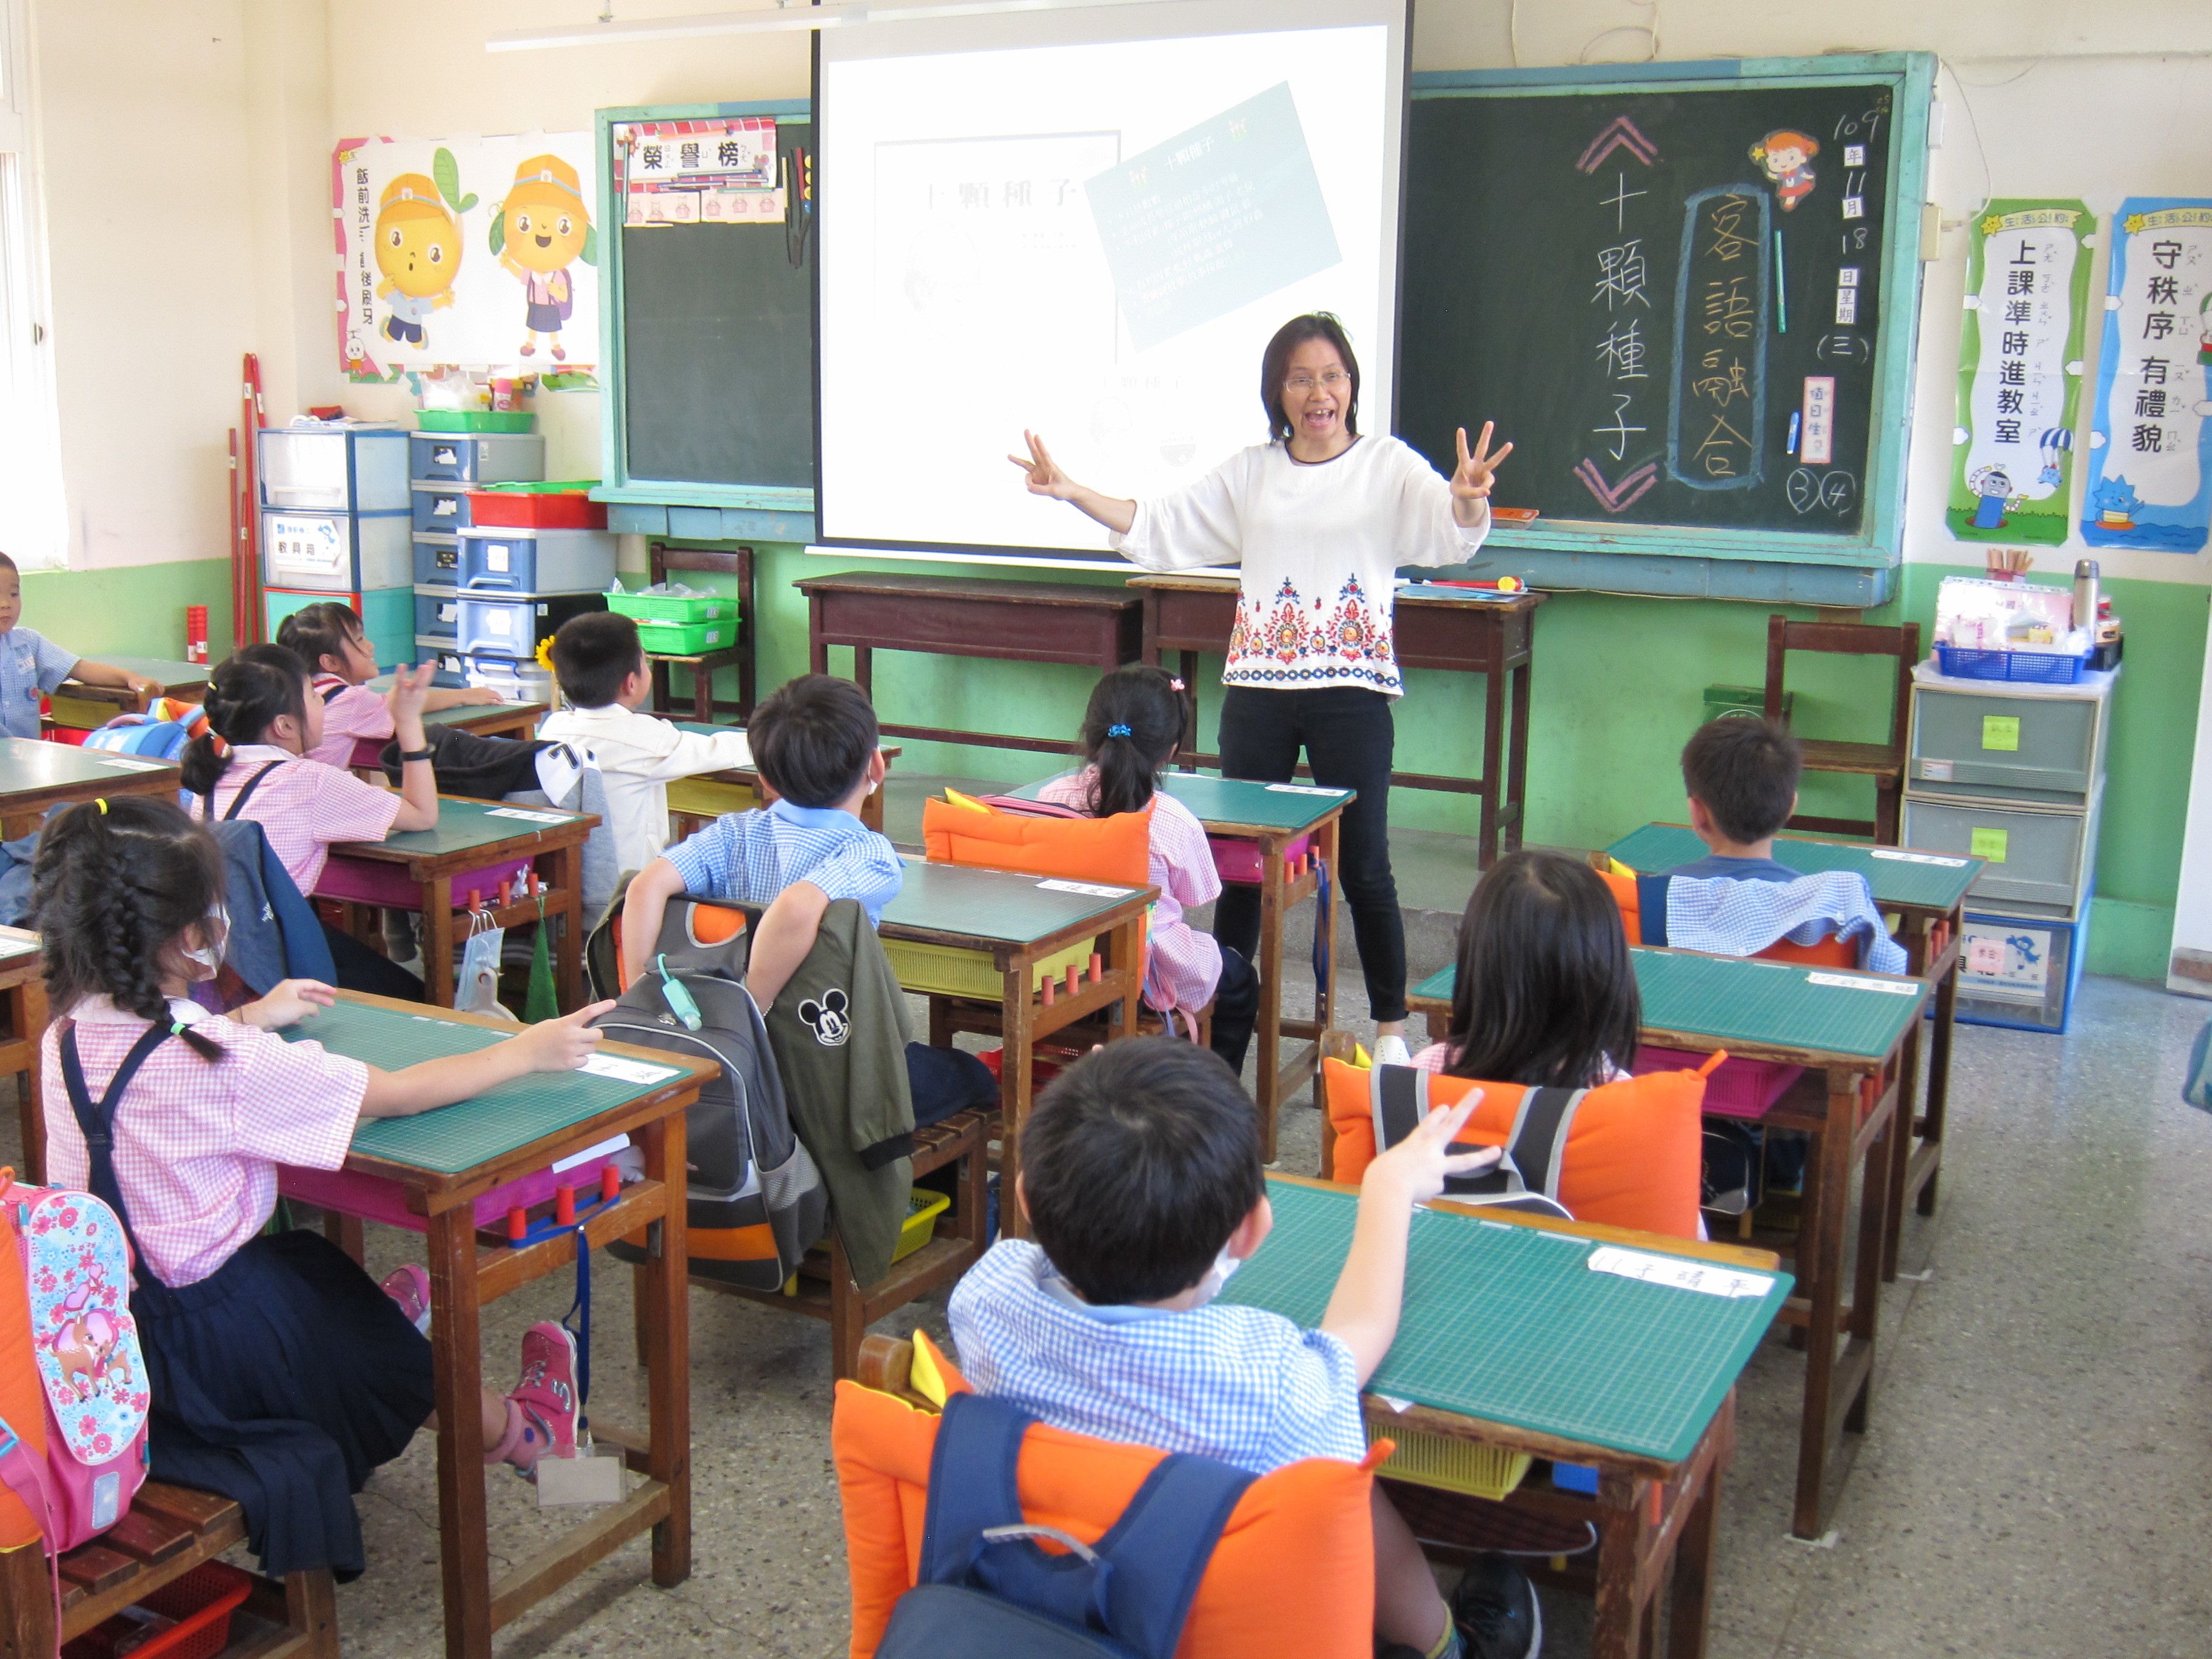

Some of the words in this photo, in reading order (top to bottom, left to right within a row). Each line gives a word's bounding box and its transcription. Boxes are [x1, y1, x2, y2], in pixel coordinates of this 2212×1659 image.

[643, 141, 739, 169] 榮譽榜
[1834, 110, 1879, 143] 109
[1847, 149, 1862, 164] 年
[1846, 171, 1866, 198] 11
[1843, 227, 1868, 254] 18
[1590, 172, 1651, 460] 十顆種子
[2143, 240, 2182, 340] 守秩序
[1692, 195, 1759, 477] 客語融合
[1994, 240, 2036, 443] 上課準時進教室
[2132, 355, 2170, 452] 有禮貌
